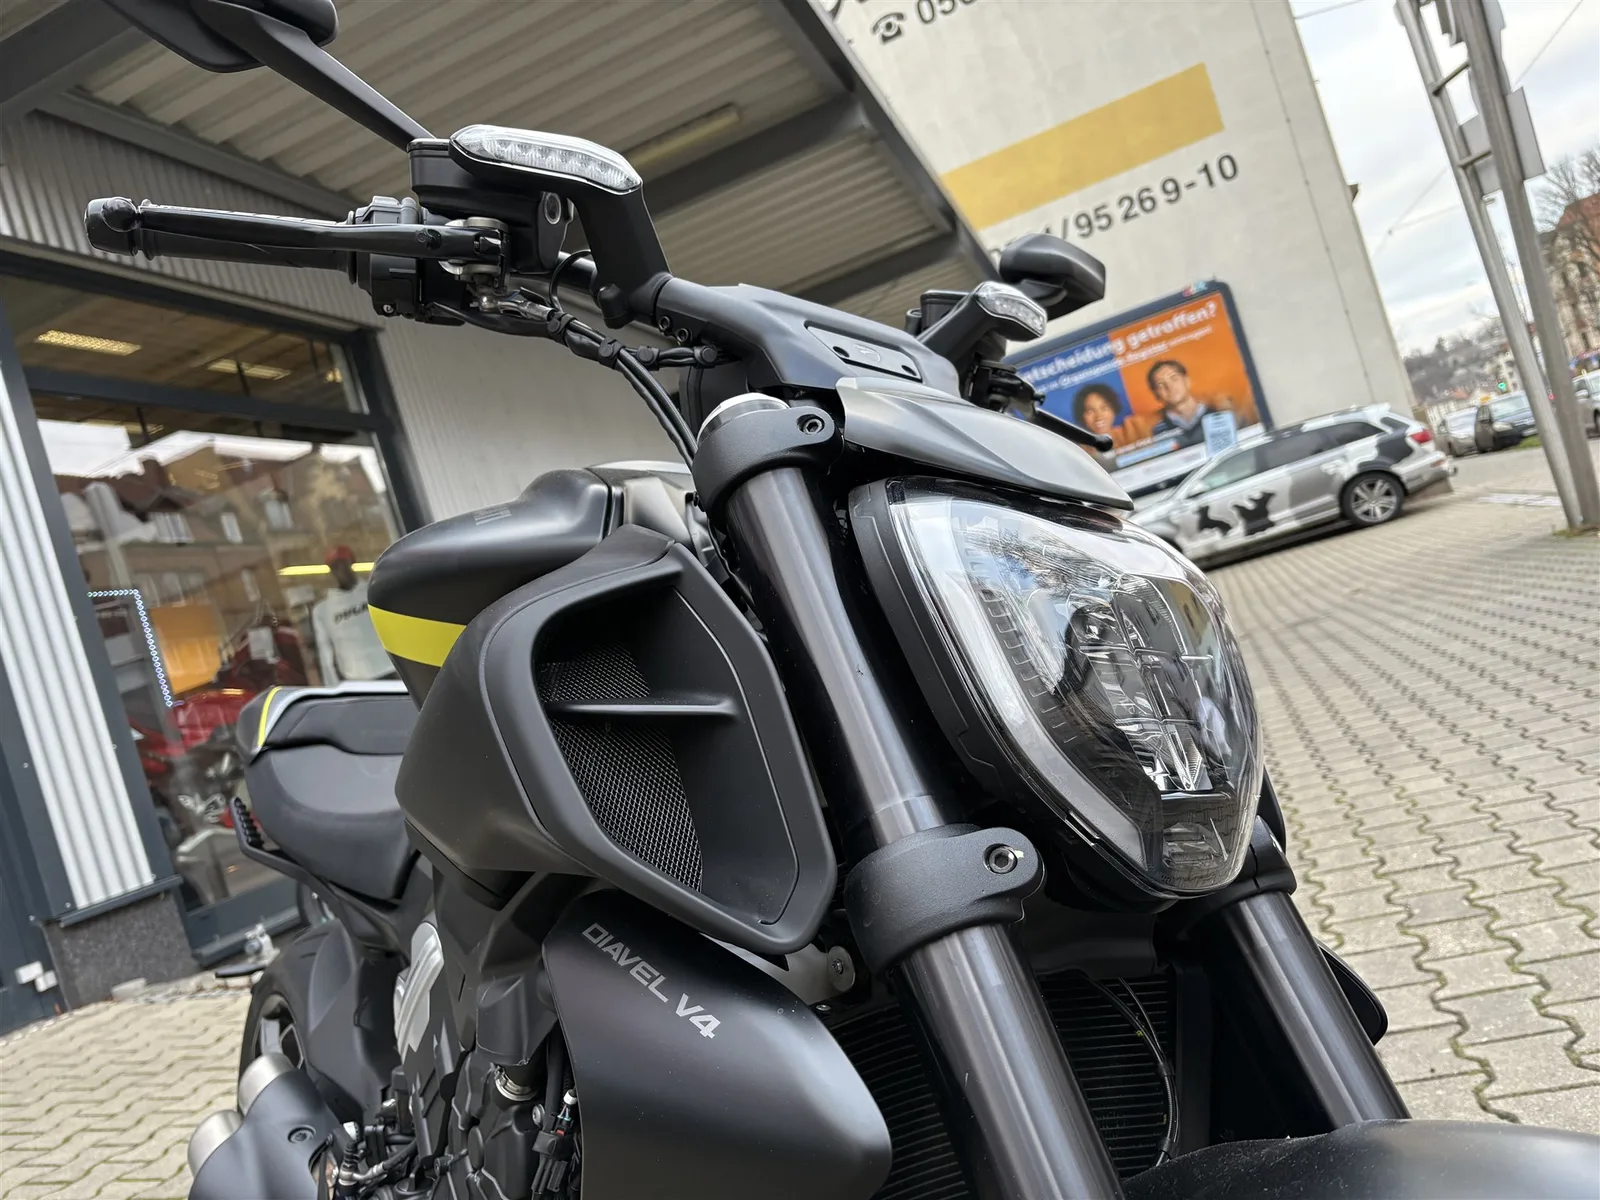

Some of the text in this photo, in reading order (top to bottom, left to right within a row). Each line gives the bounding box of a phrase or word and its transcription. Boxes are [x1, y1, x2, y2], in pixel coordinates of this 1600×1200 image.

[1118, 187, 1157, 222] 26
[1017, 337, 1126, 383] ntscheidung
[1126, 300, 1217, 350] getroffen?
[582, 922, 721, 1039] DIAVEL V4
